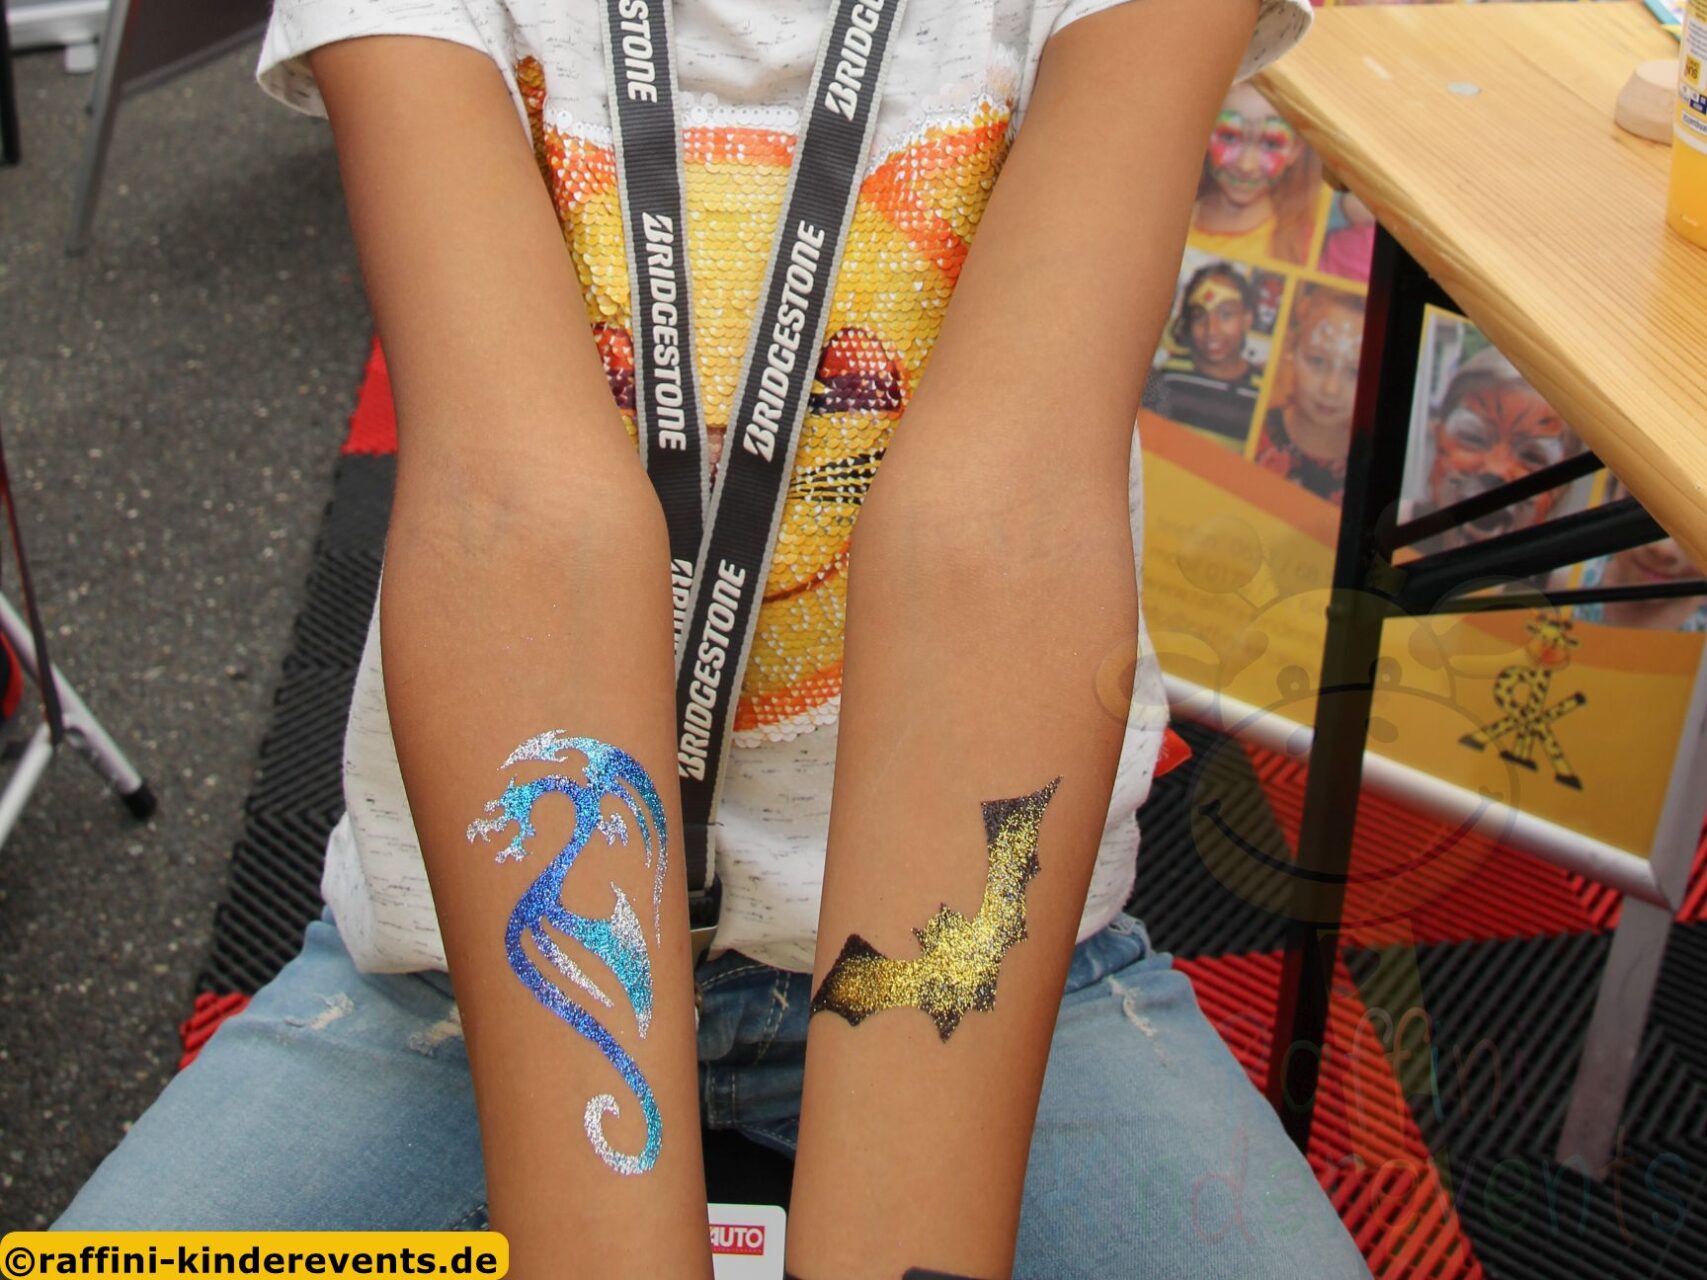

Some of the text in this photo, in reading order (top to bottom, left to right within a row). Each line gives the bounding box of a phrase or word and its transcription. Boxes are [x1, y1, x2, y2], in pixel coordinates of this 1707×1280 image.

[641, 211, 688, 452] BRIDGESTONE
[743, 220, 826, 463] BRIDGESTONE
[678, 558, 746, 781] BRIDGESTONE
